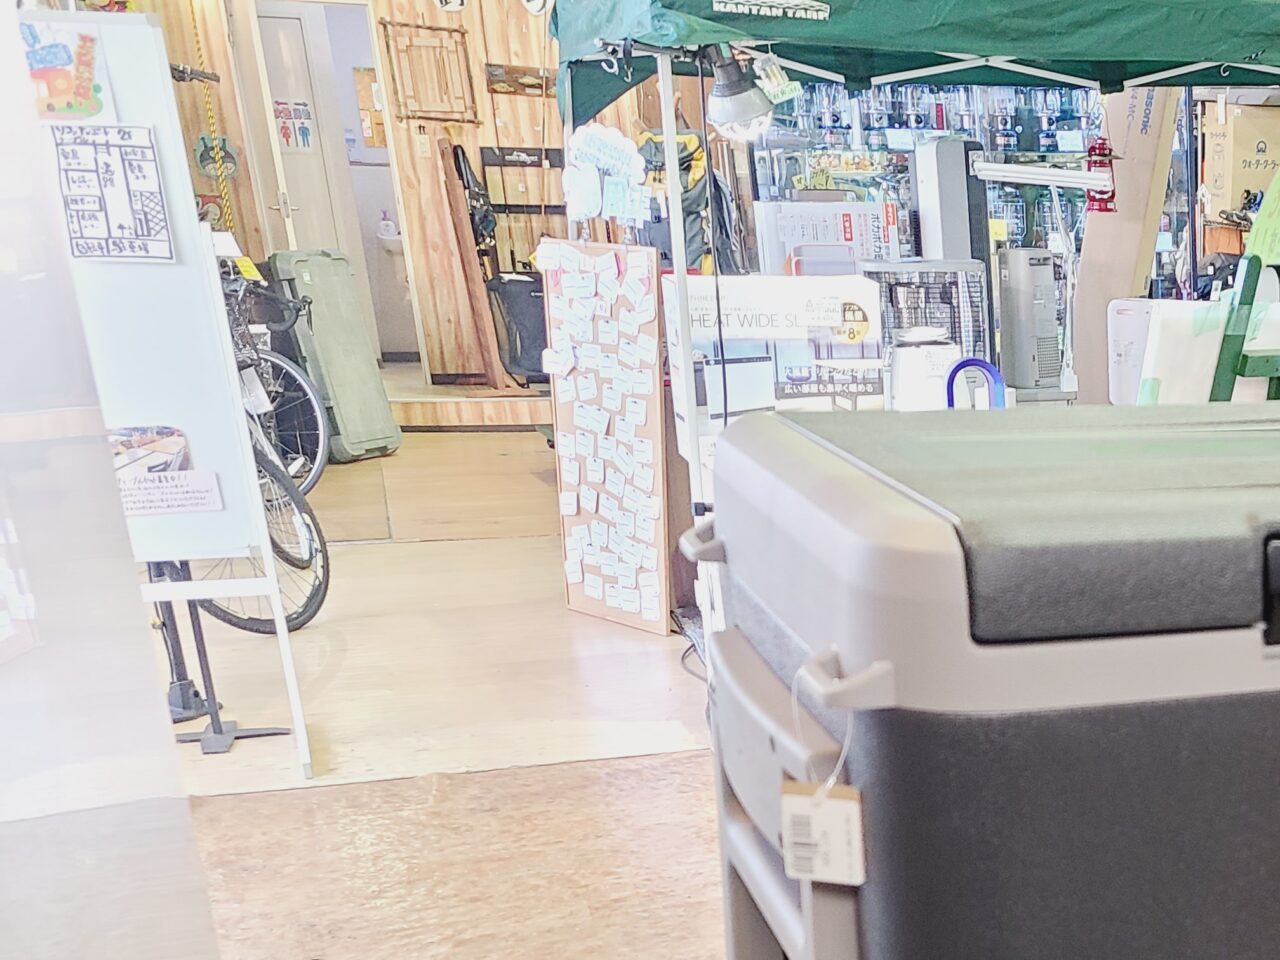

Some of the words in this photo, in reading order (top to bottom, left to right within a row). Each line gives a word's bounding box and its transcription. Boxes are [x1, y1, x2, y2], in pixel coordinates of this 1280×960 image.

[713, 2, 783, 17] KANTAN
[690, 313, 732, 328] HEAT
[737, 313, 779, 328] WIDE
